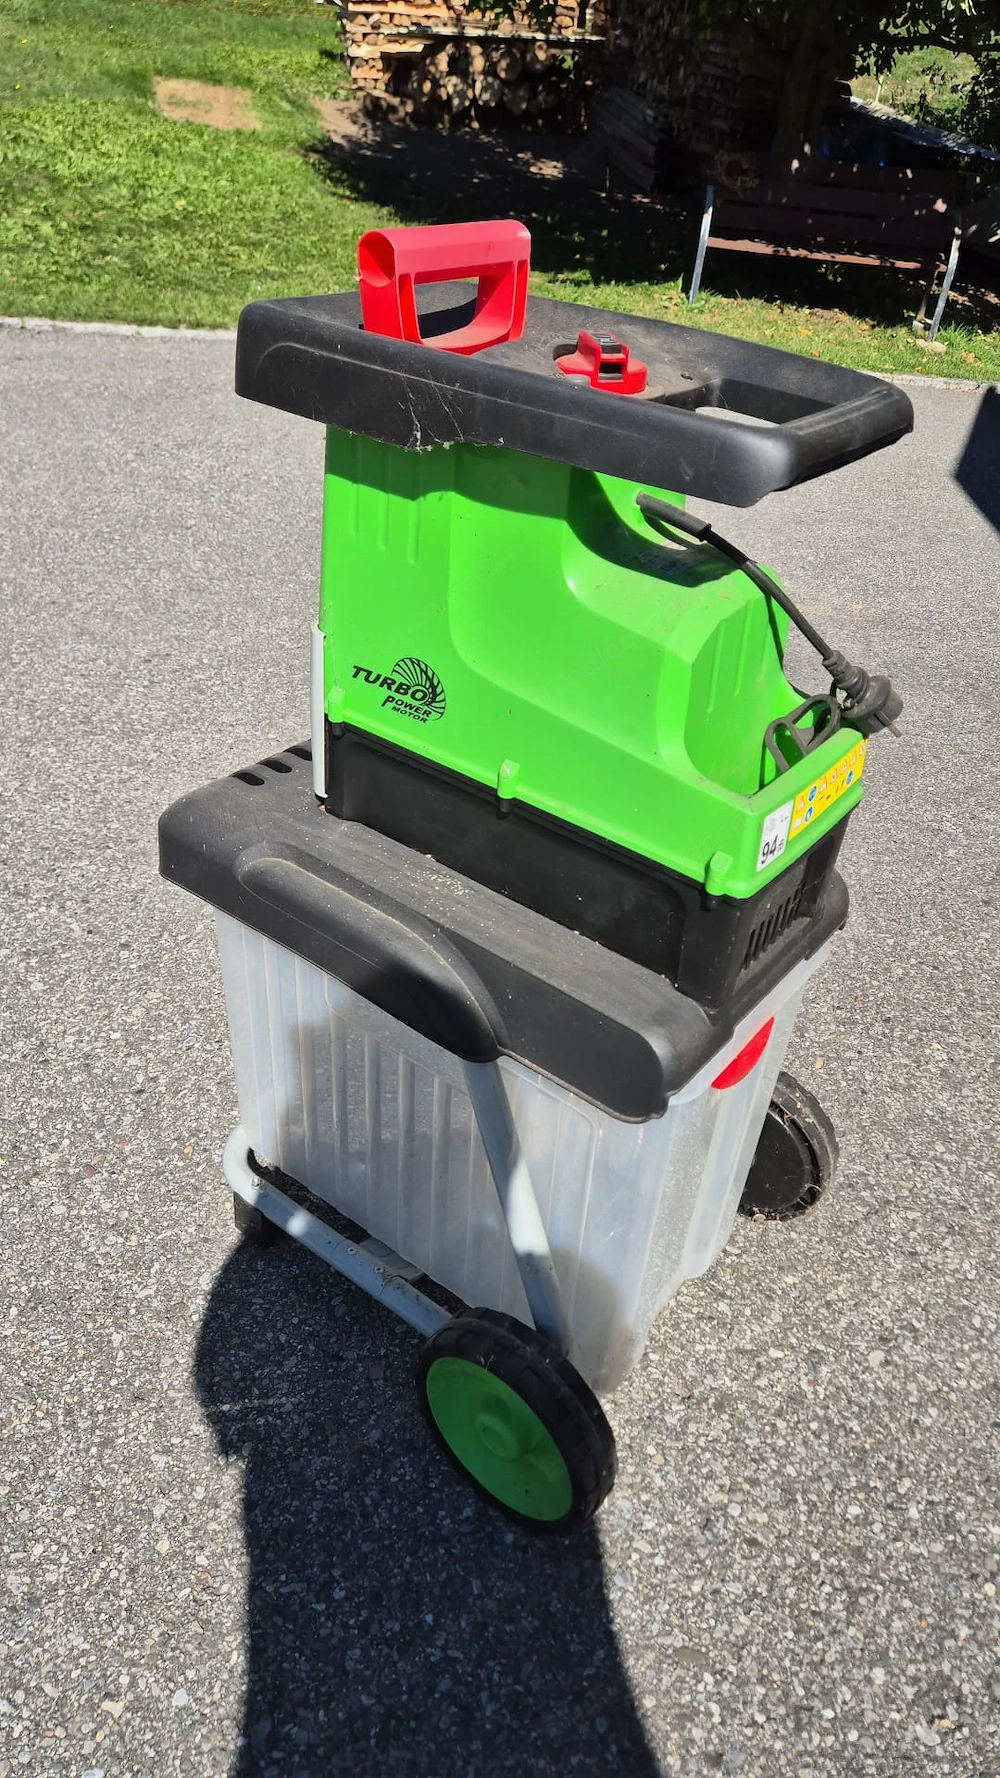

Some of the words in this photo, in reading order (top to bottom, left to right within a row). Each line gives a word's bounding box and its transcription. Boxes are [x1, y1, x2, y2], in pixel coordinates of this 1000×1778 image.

[352, 665, 428, 702] TURBO
[381, 695, 432, 718] POWER
[391, 706, 429, 724] MOTOR
[761, 834, 778, 865] 94
